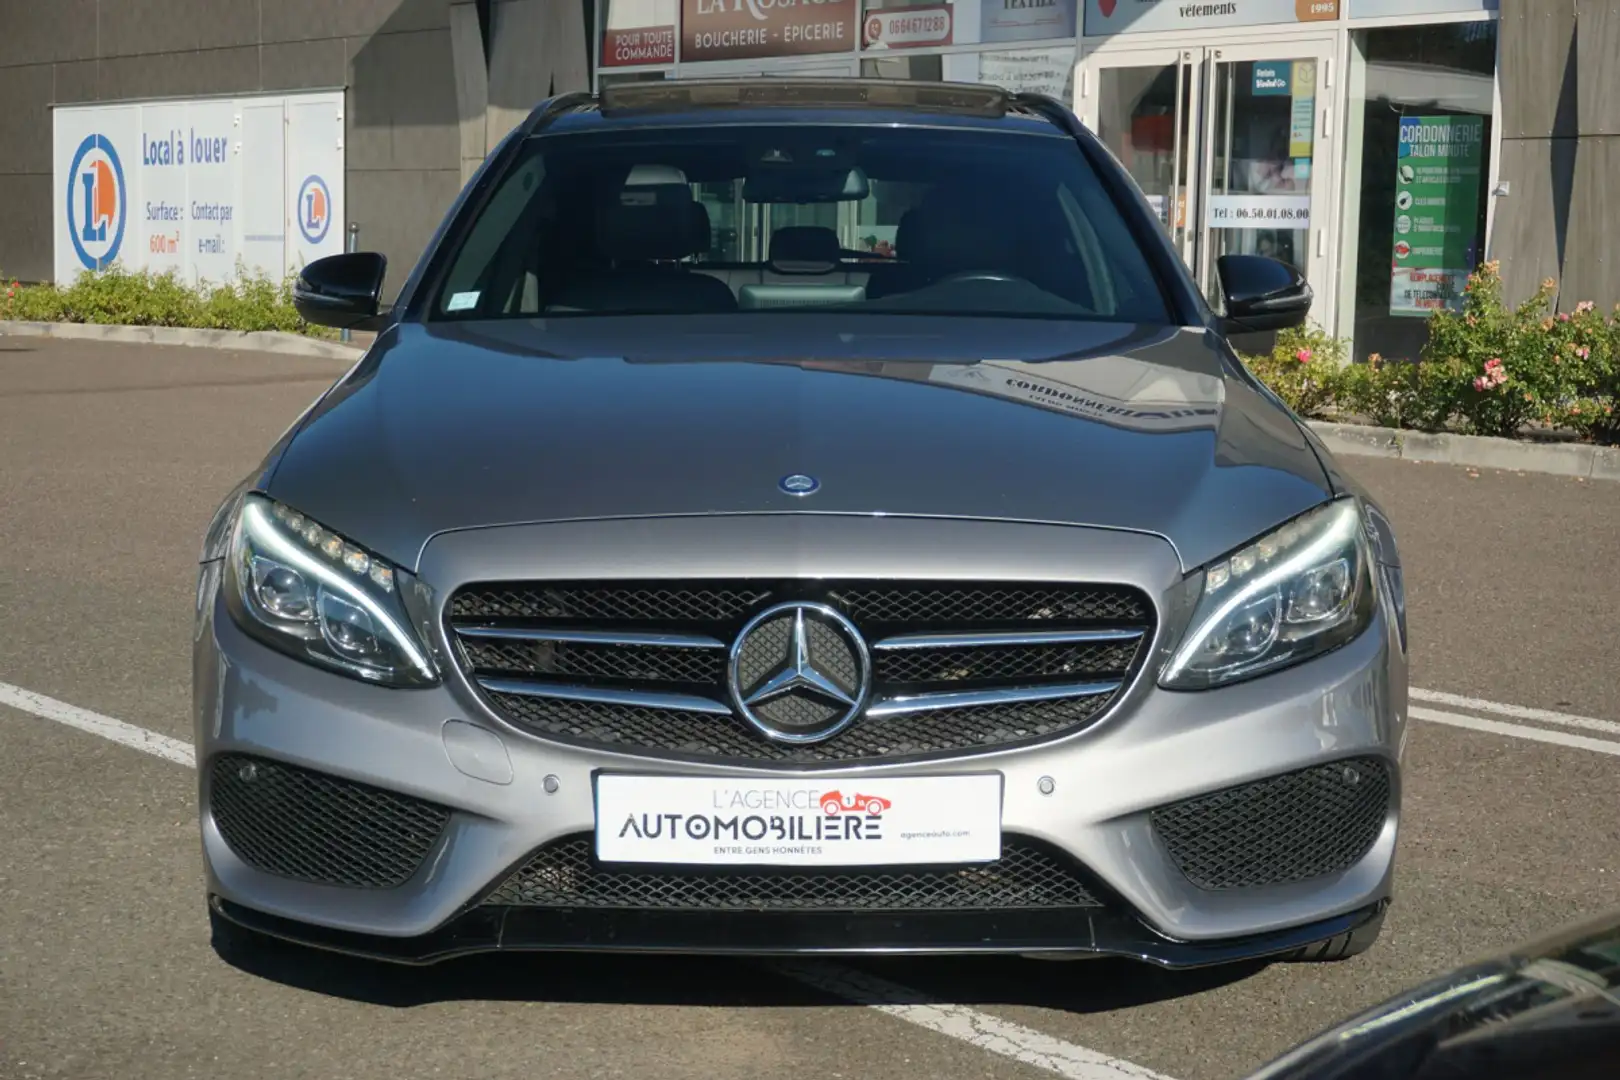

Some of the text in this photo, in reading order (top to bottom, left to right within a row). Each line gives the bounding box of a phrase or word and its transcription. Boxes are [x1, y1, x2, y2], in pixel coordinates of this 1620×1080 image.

[1179, 2, 1237, 18] vêtements
[615, 31, 672, 47] POUR TOUTE
[694, 28, 767, 49] BOUCHERIE
[784, 21, 844, 42] ÉPICERIE
[615, 44, 673, 61] COMMANDE
[1400, 123, 1481, 143] CORDONNERIE
[143, 125, 227, 166] Local à louer
[1409, 143, 1470, 157] TALON MINUTE
[146, 200, 179, 221] Surface
[191, 200, 233, 225] Contact par
[1235, 206, 1310, 219] 06.50.01.08.00
[150, 233, 166, 254] 600
[713, 789, 820, 810] L'AGENCE
[713, 846, 743, 855] ENTRE
[745, 846, 771, 855] GENS
